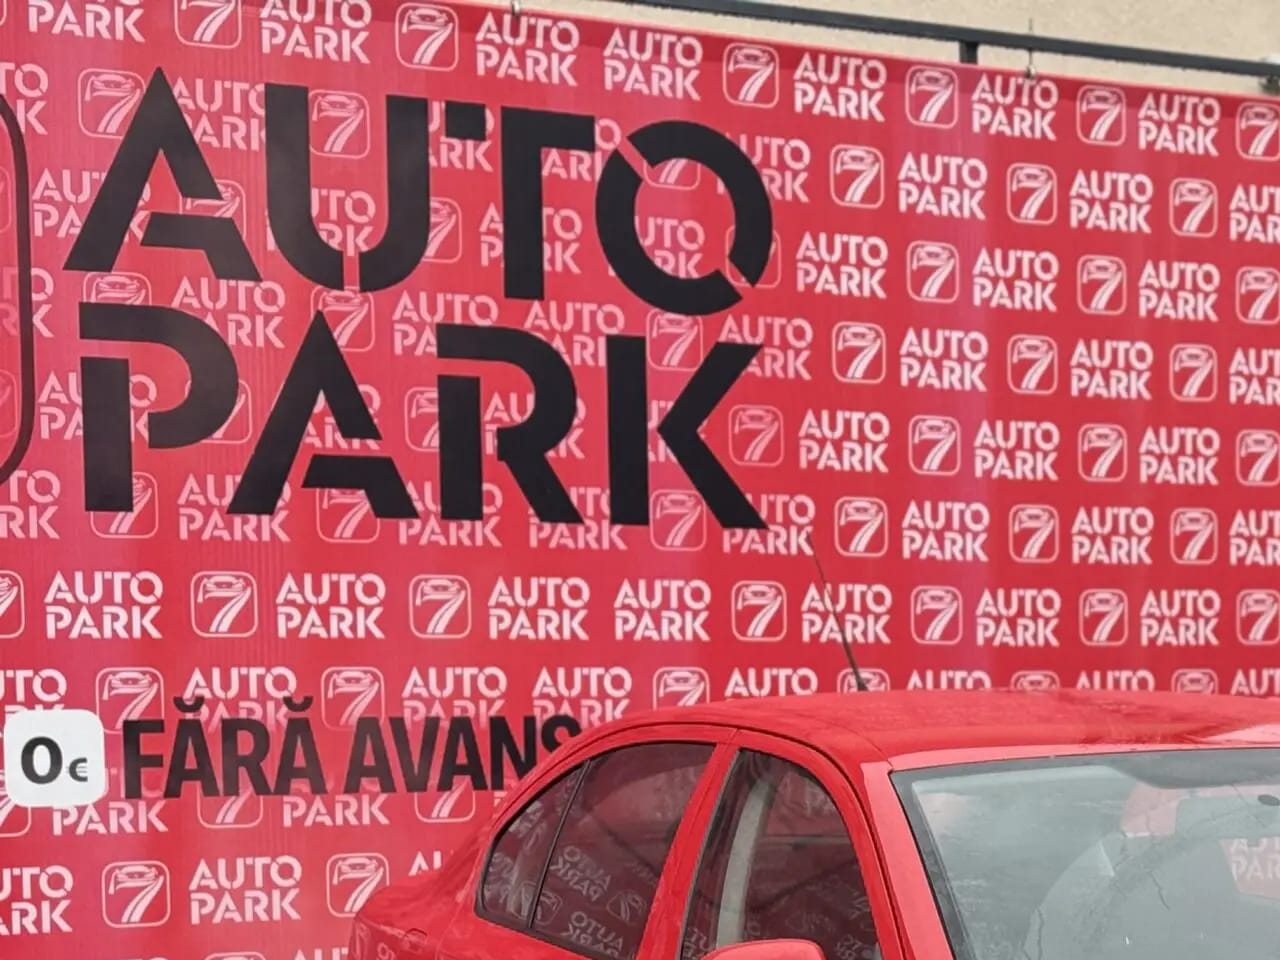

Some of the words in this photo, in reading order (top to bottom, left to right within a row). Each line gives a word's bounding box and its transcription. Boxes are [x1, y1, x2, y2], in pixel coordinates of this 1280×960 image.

[28, 1, 146, 43] PARK
[260, 0, 372, 29] AUTO
[261, 22, 371, 64] PARK
[475, 12, 580, 53] AUTO
[603, 28, 703, 67] AUTO
[0, 62, 48, 98] TO
[476, 45, 577, 87] PARK
[604, 59, 701, 101] PARK
[794, 52, 887, 89] AUTO
[794, 88, 885, 122] PARK
[972, 74, 1058, 108] AUTO
[972, 105, 1056, 140] PARK
[1139, 94, 1220, 125] AUTO
[739, 134, 810, 170] UTO
[1139, 123, 1219, 156] PARK
[898, 154, 987, 186] AUTO
[62, 67, 773, 315] AUTO
[898, 185, 985, 219] PARK
[1070, 171, 1153, 202] AUTO
[312, 188, 376, 222] TO
[1071, 201, 1152, 234] PARK
[33, 203, 151, 241] PAK
[480, 203, 582, 241] ATO
[635, 216, 704, 250] UTO
[796, 233, 888, 266] AUTO
[973, 249, 1058, 280] AUTO
[796, 264, 887, 298] PARK
[1139, 263, 1220, 292] AUTO
[171, 276, 285, 313] AUTO
[393, 291, 498, 326] AUTO
[973, 279, 1057, 312] PARK
[1139, 291, 1219, 322] PARK
[205, 313, 285, 348] RK
[524, 301, 624, 332] AUTO
[719, 315, 813, 349] AUTO
[394, 325, 437, 356] PA
[900, 329, 988, 360] AUTO
[1071, 341, 1153, 371] AUTO
[900, 358, 986, 392] PARK
[1071, 369, 1152, 400] PARK
[79, 301, 769, 530] PARK
[799, 411, 889, 441] AUTO
[974, 421, 1059, 452] AUTO
[1139, 428, 1220, 457] AUTO
[799, 439, 889, 472] PARK
[974, 450, 1058, 481] PARK
[1139, 456, 1218, 486] PARK
[8, 470, 60, 503] TO
[405, 481, 502, 513] AUO
[0, 505, 60, 540] RK
[746, 495, 815, 524] UTO
[902, 502, 990, 532] AUTO
[1072, 508, 1154, 536] AUTO
[179, 510, 290, 543] PARK
[399, 518, 501, 550] PARK
[529, 523, 627, 551] PARK
[723, 527, 814, 556] PARK
[902, 530, 988, 562] PARK
[1072, 534, 1152, 565] PARK
[44, 571, 163, 604] AUTO
[275, 573, 386, 605] AUTO
[489, 576, 590, 608] AUTO
[614, 578, 711, 609] AUTO
[801, 584, 891, 614] AUTO
[976, 589, 1061, 618] AUTO
[1141, 590, 1221, 618] AUTO
[45, 605, 163, 640] PARK
[277, 606, 385, 640] PARK
[490, 609, 589, 640] PARK
[615, 610, 710, 642] PARK
[801, 612, 891, 644] PARK
[976, 616, 1060, 647] PARK
[1141, 616, 1219, 646] PARK
[0, 668, 67, 703] TO
[182, 666, 297, 700] AUTO
[402, 667, 507, 697] AUTO
[532, 667, 632, 697] AUTO
[725, 668, 818, 697] AUTO
[907, 671, 991, 692] AUTO
[1076, 670, 1155, 693] AUTO
[122, 696, 328, 800] FĂRĂ
[52, 801, 168, 835] PARK
[283, 798, 390, 827] PARK
[189, 855, 301, 891] AUTO
[190, 889, 301, 925] PARK
